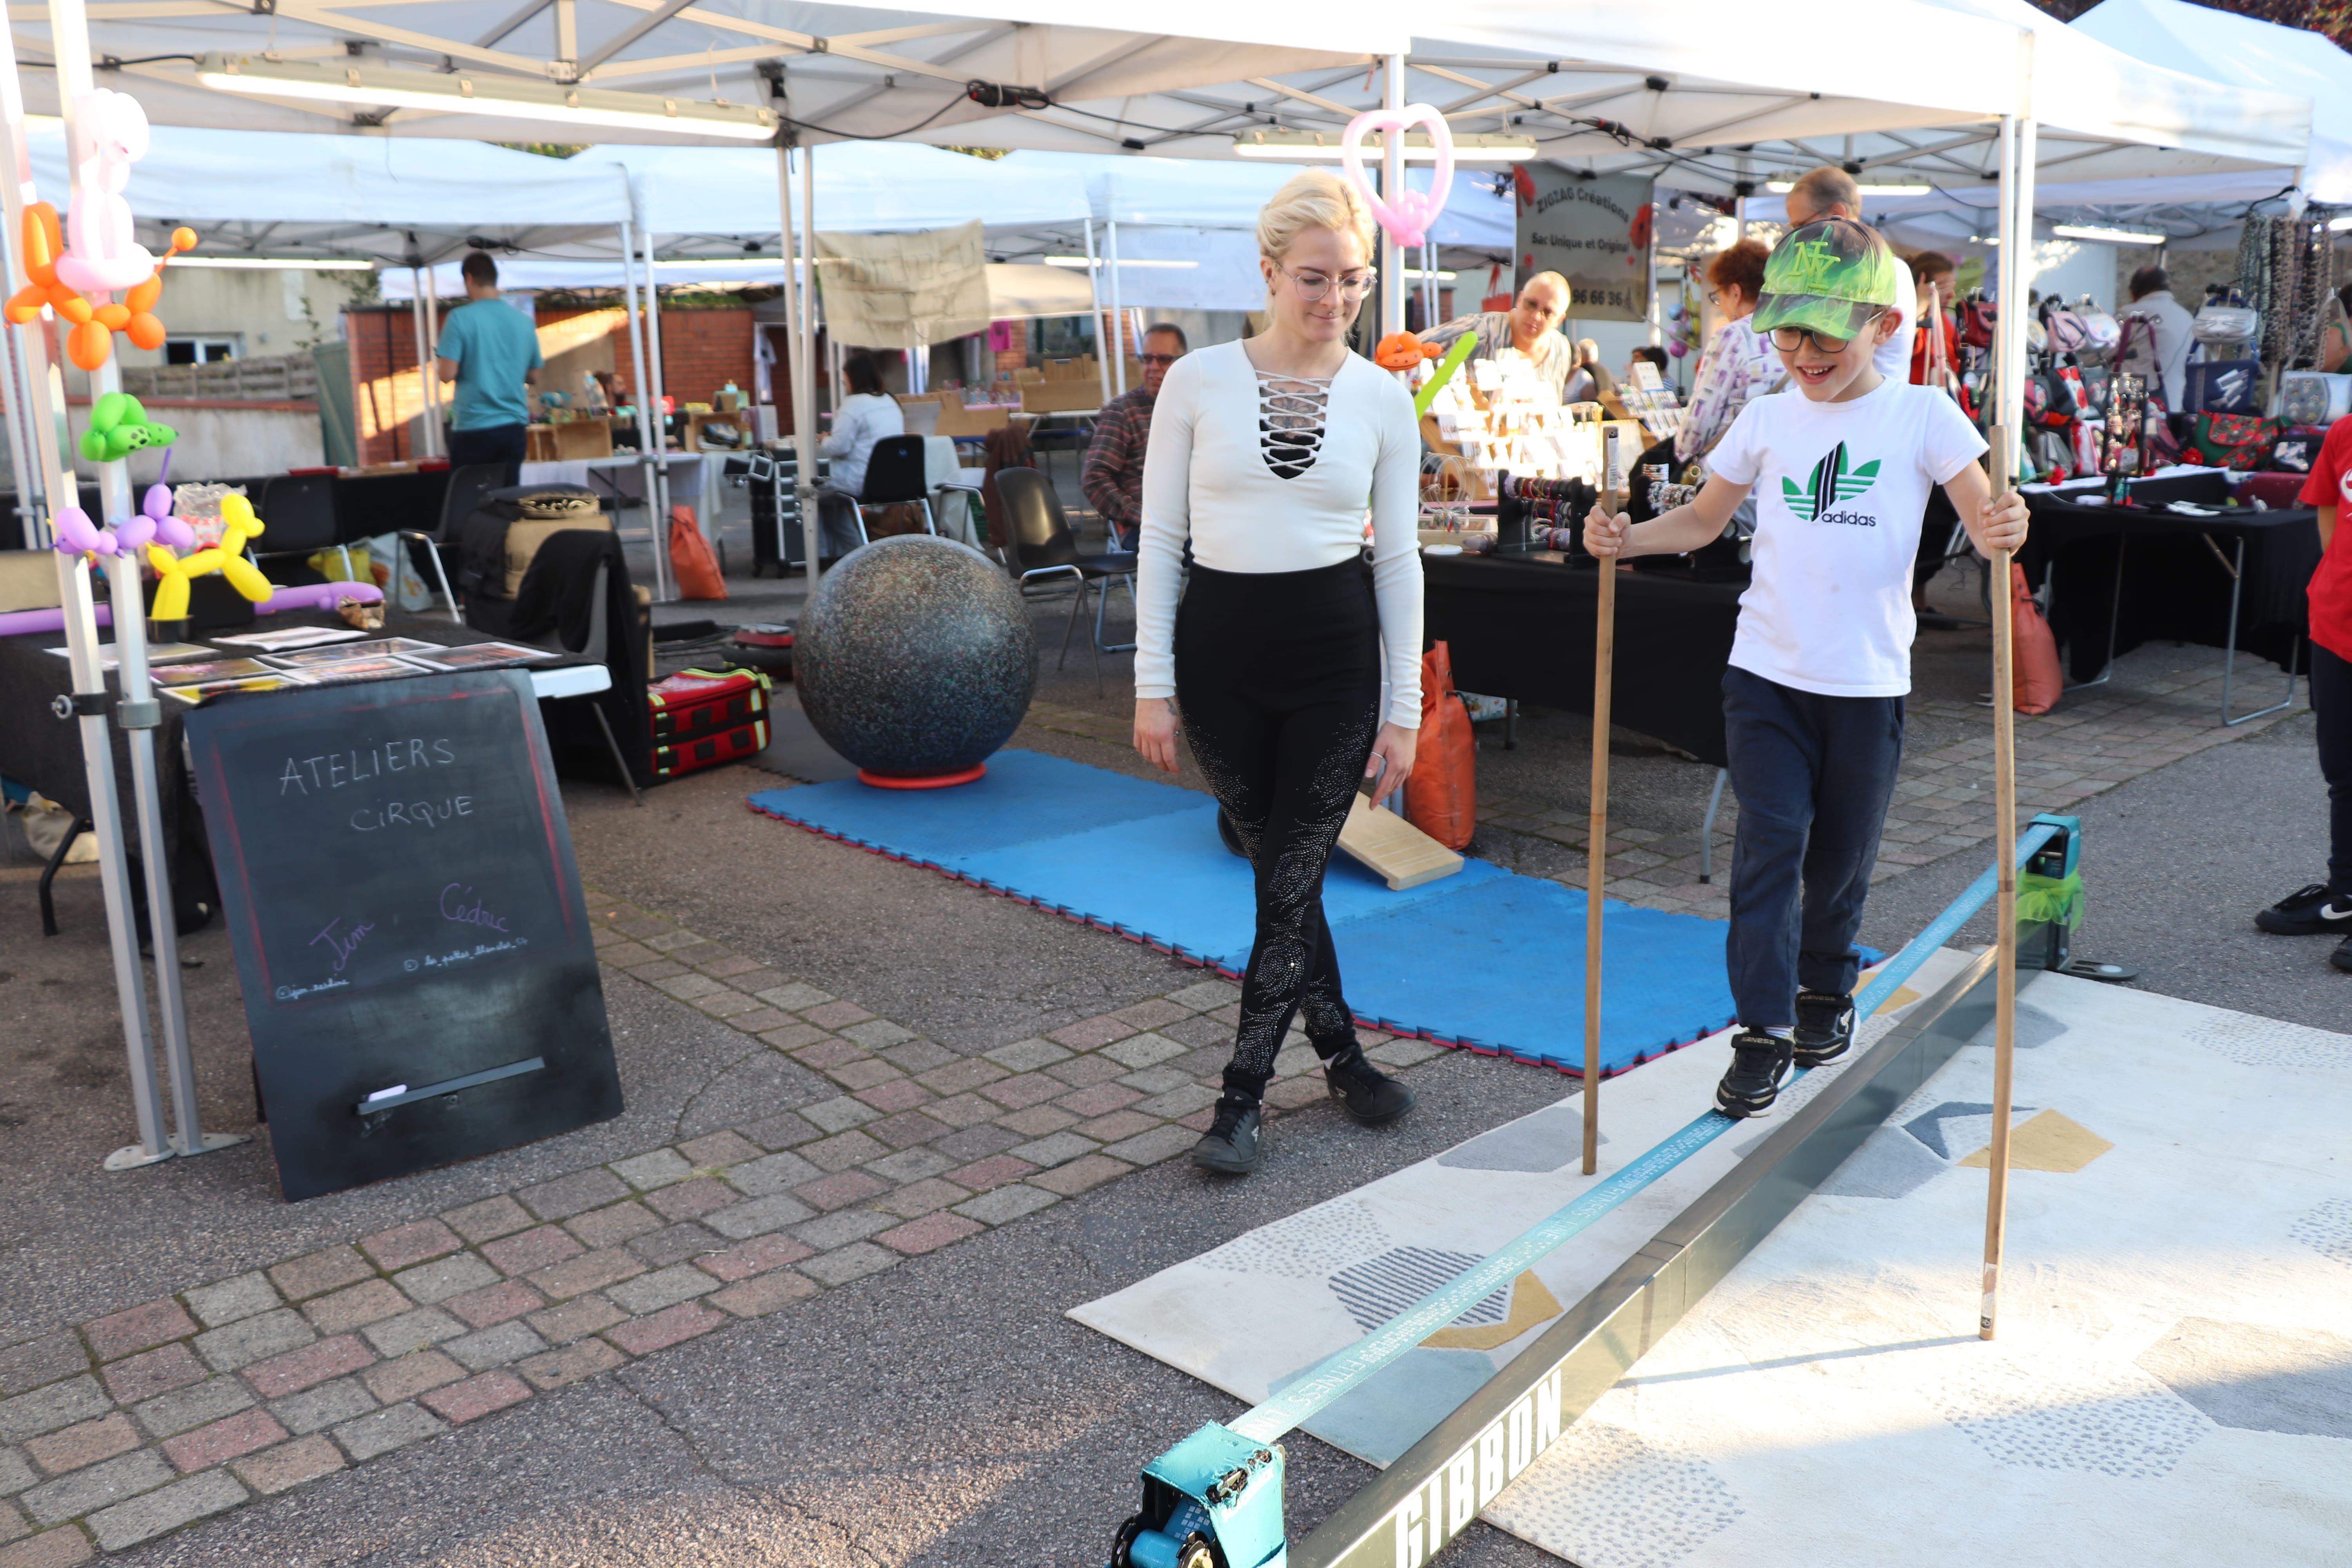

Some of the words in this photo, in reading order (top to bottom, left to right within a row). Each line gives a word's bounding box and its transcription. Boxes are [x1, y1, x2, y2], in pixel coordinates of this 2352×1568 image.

[1537, 187, 1575, 214] ZIGZAG
[1577, 187, 1630, 223] Créations
[1532, 232, 1548, 245] Sac
[1550, 234, 1583, 250] Unique
[1585, 239, 1595, 249] et
[1597, 238, 1629, 254] Original
[1573, 288, 1587, 304] 96
[1822, 510, 1876, 527] adidas
[439, 883, 509, 933] Cédric
[309, 917, 375, 971] Jim
[1572, 1186, 1625, 1216] FITNESS
[1288, 1359, 1366, 1406] FITNESS
[1396, 1368, 1561, 1568] GIBBON
